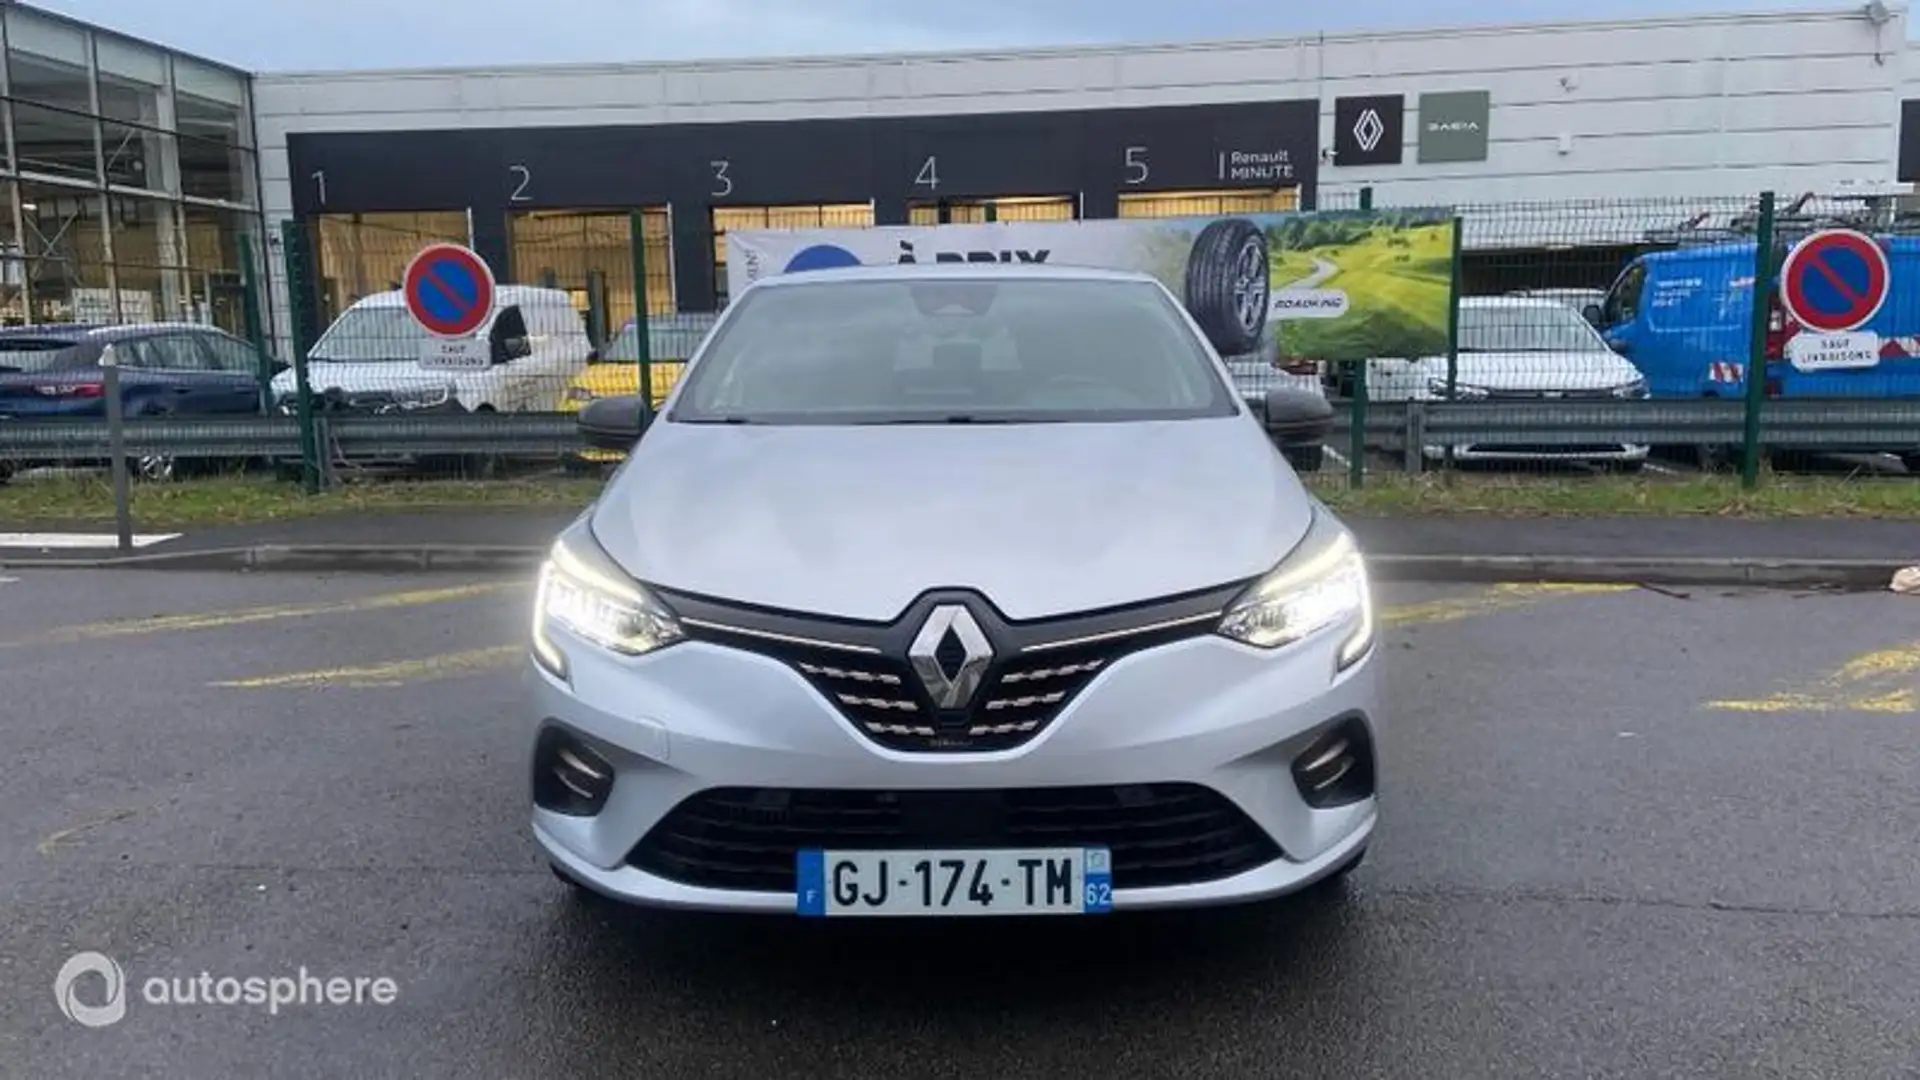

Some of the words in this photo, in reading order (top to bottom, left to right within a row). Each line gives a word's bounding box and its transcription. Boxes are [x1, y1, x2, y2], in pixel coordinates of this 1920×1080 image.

[914, 155, 940, 190] 4
[1125, 146, 1149, 184] 5
[1231, 150, 1288, 164] Renault
[1231, 164, 1294, 179] MINUTE
[311, 170, 326, 206] 1
[509, 164, 533, 200] 2
[710, 160, 732, 197] 3
[806, 890, 817, 904] F
[832, 858, 1072, 907] GJ-174-TM
[1087, 882, 1110, 905] 62
